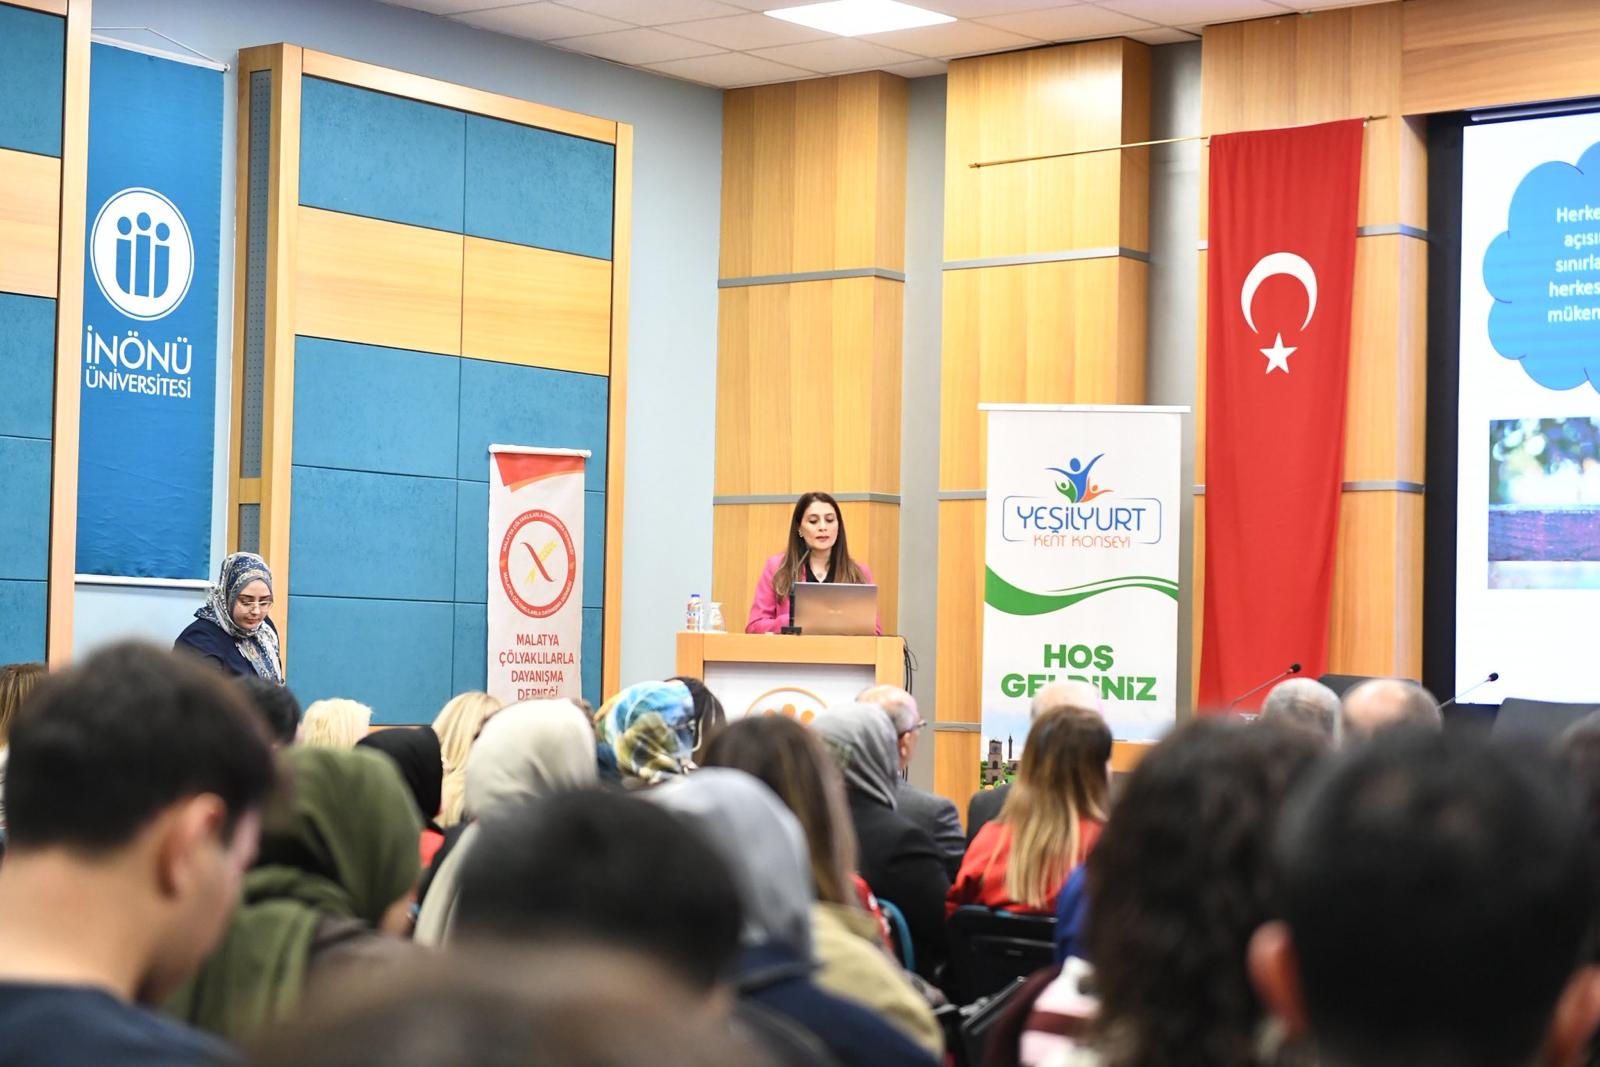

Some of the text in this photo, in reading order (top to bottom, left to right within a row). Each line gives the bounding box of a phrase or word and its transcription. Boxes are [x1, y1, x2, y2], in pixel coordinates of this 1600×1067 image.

[1564, 232, 1600, 250] açısı
[86, 325, 192, 374] İNÖNÜ
[85, 365, 191, 398] ÜNİVERSİTESİ
[1017, 506, 1146, 533] YEŞİLYURT
[1034, 534, 1066, 547] KENT
[516, 633, 560, 646] MALATYA
[499, 649, 574, 667] ÇÖLYAKLILARLA
[1043, 643, 1114, 672] HOŞ
[511, 670, 564, 685] DAYANIŞMA
